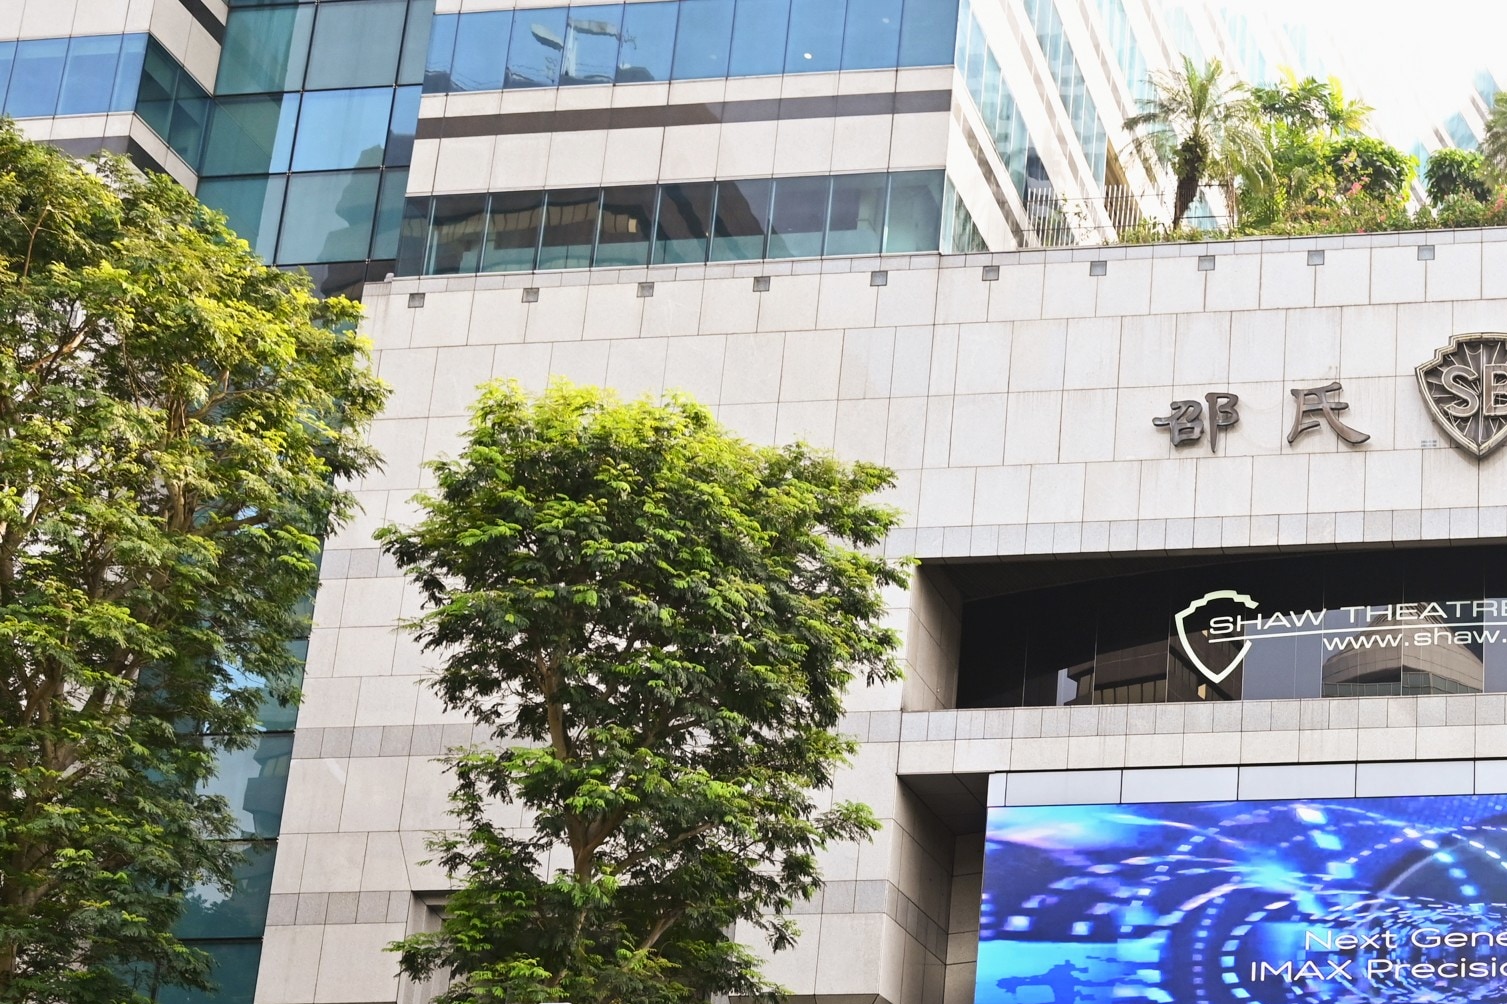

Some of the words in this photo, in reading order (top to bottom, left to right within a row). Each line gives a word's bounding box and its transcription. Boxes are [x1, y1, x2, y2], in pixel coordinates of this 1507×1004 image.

[1209, 606, 1327, 636] SHAW
[1304, 925, 1397, 951] Next
[1249, 957, 1354, 983] IMAX
